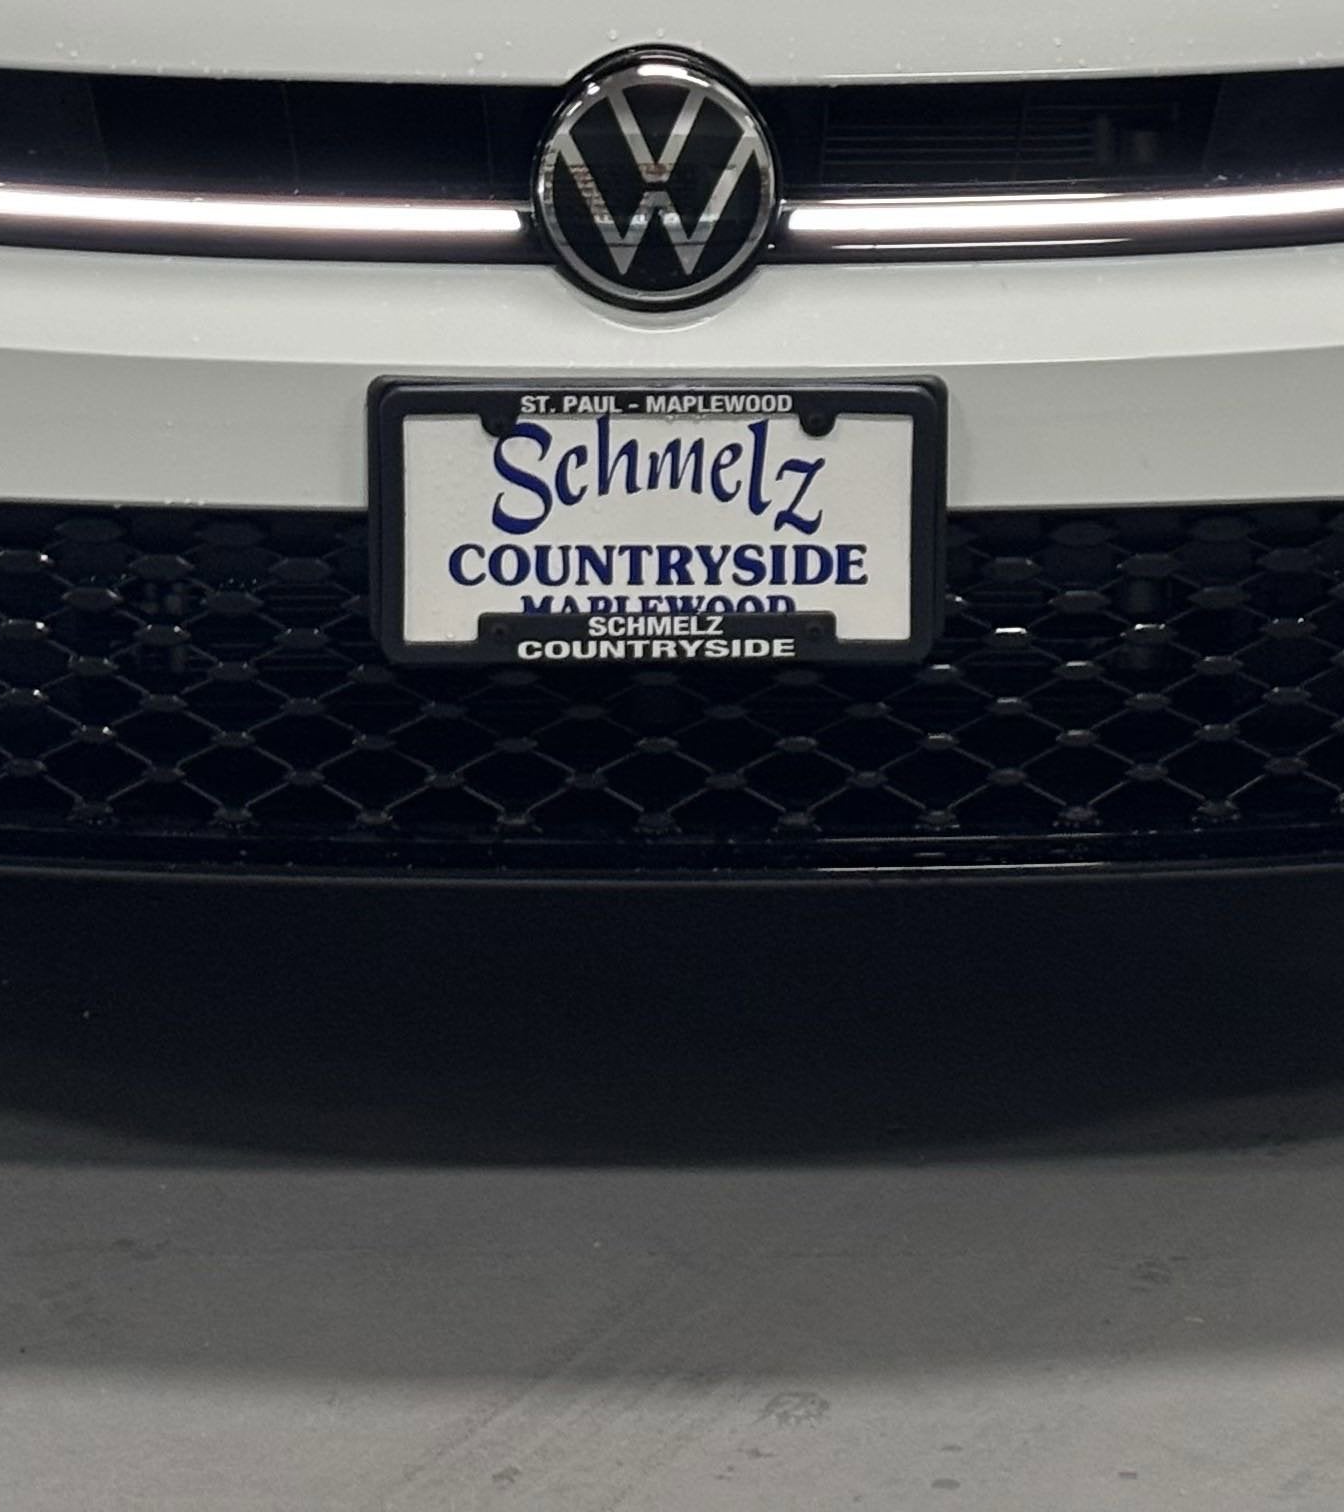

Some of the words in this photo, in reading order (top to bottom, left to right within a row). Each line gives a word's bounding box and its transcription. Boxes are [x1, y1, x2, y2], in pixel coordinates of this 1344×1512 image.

[520, 395, 556, 413] ST.
[562, 395, 622, 413] PAUL
[646, 394, 793, 413] MAPLEWOOD
[492, 416, 826, 535] Schmelz
[448, 543, 868, 587] COUNTRYSIDE
[588, 615, 724, 637] SCHMELZ
[517, 638, 796, 660] COUNTRYSIDE
